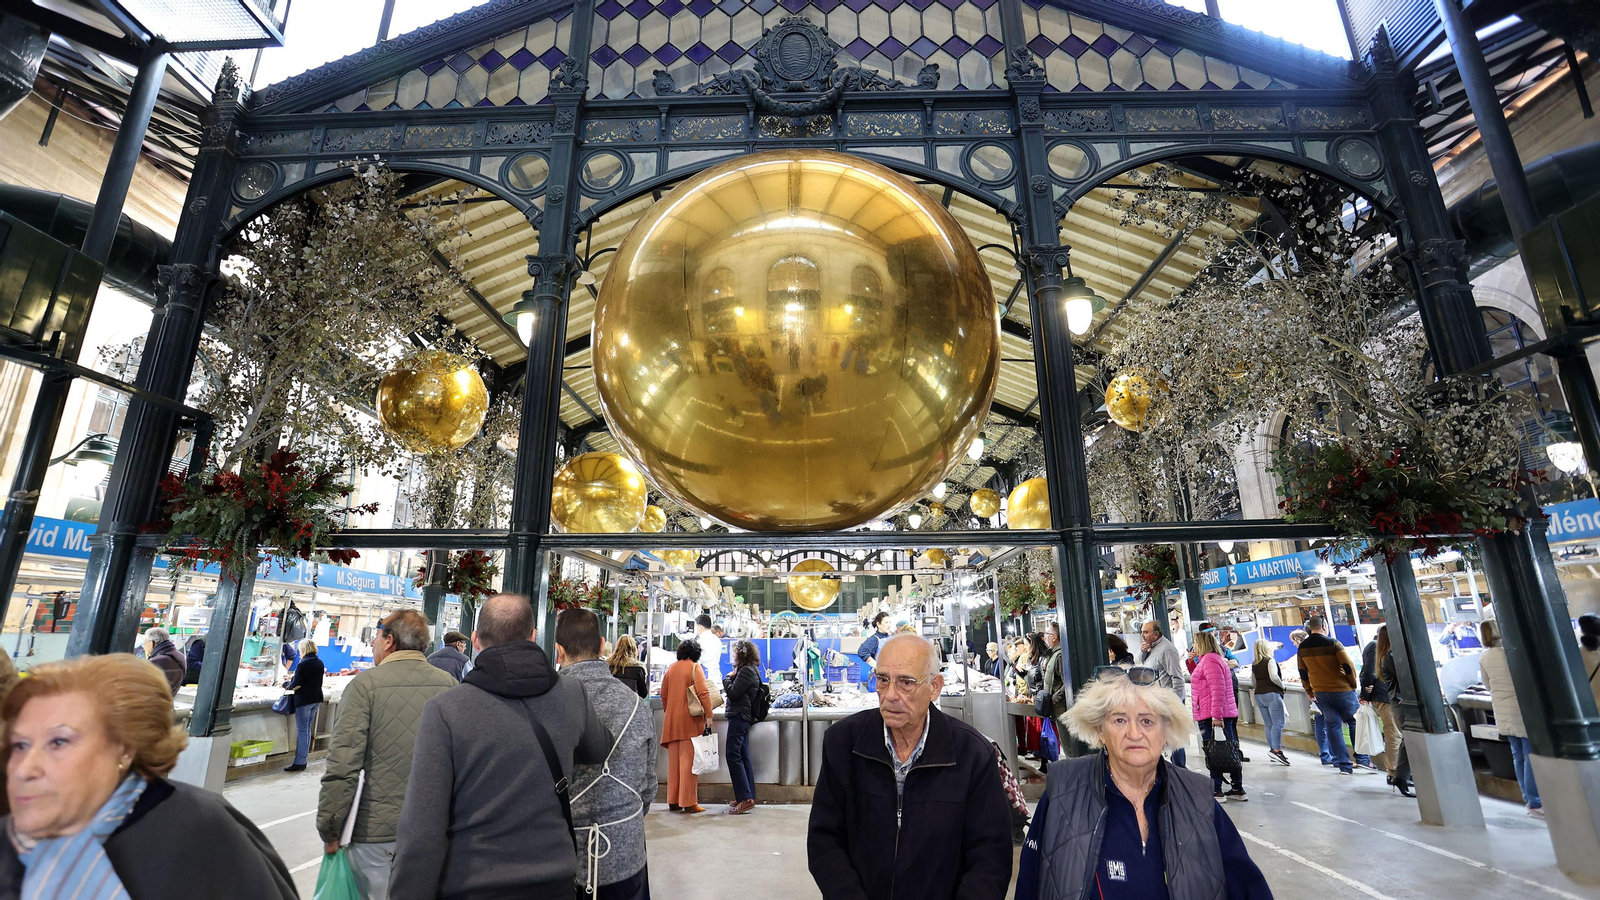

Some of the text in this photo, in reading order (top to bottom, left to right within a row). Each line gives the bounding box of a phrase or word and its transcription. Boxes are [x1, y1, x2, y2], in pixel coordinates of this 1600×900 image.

[296, 560, 314, 584] 15
[336, 570, 401, 596] M.Segura 16
[1230, 557, 1303, 585] 5 LA MARTINA
